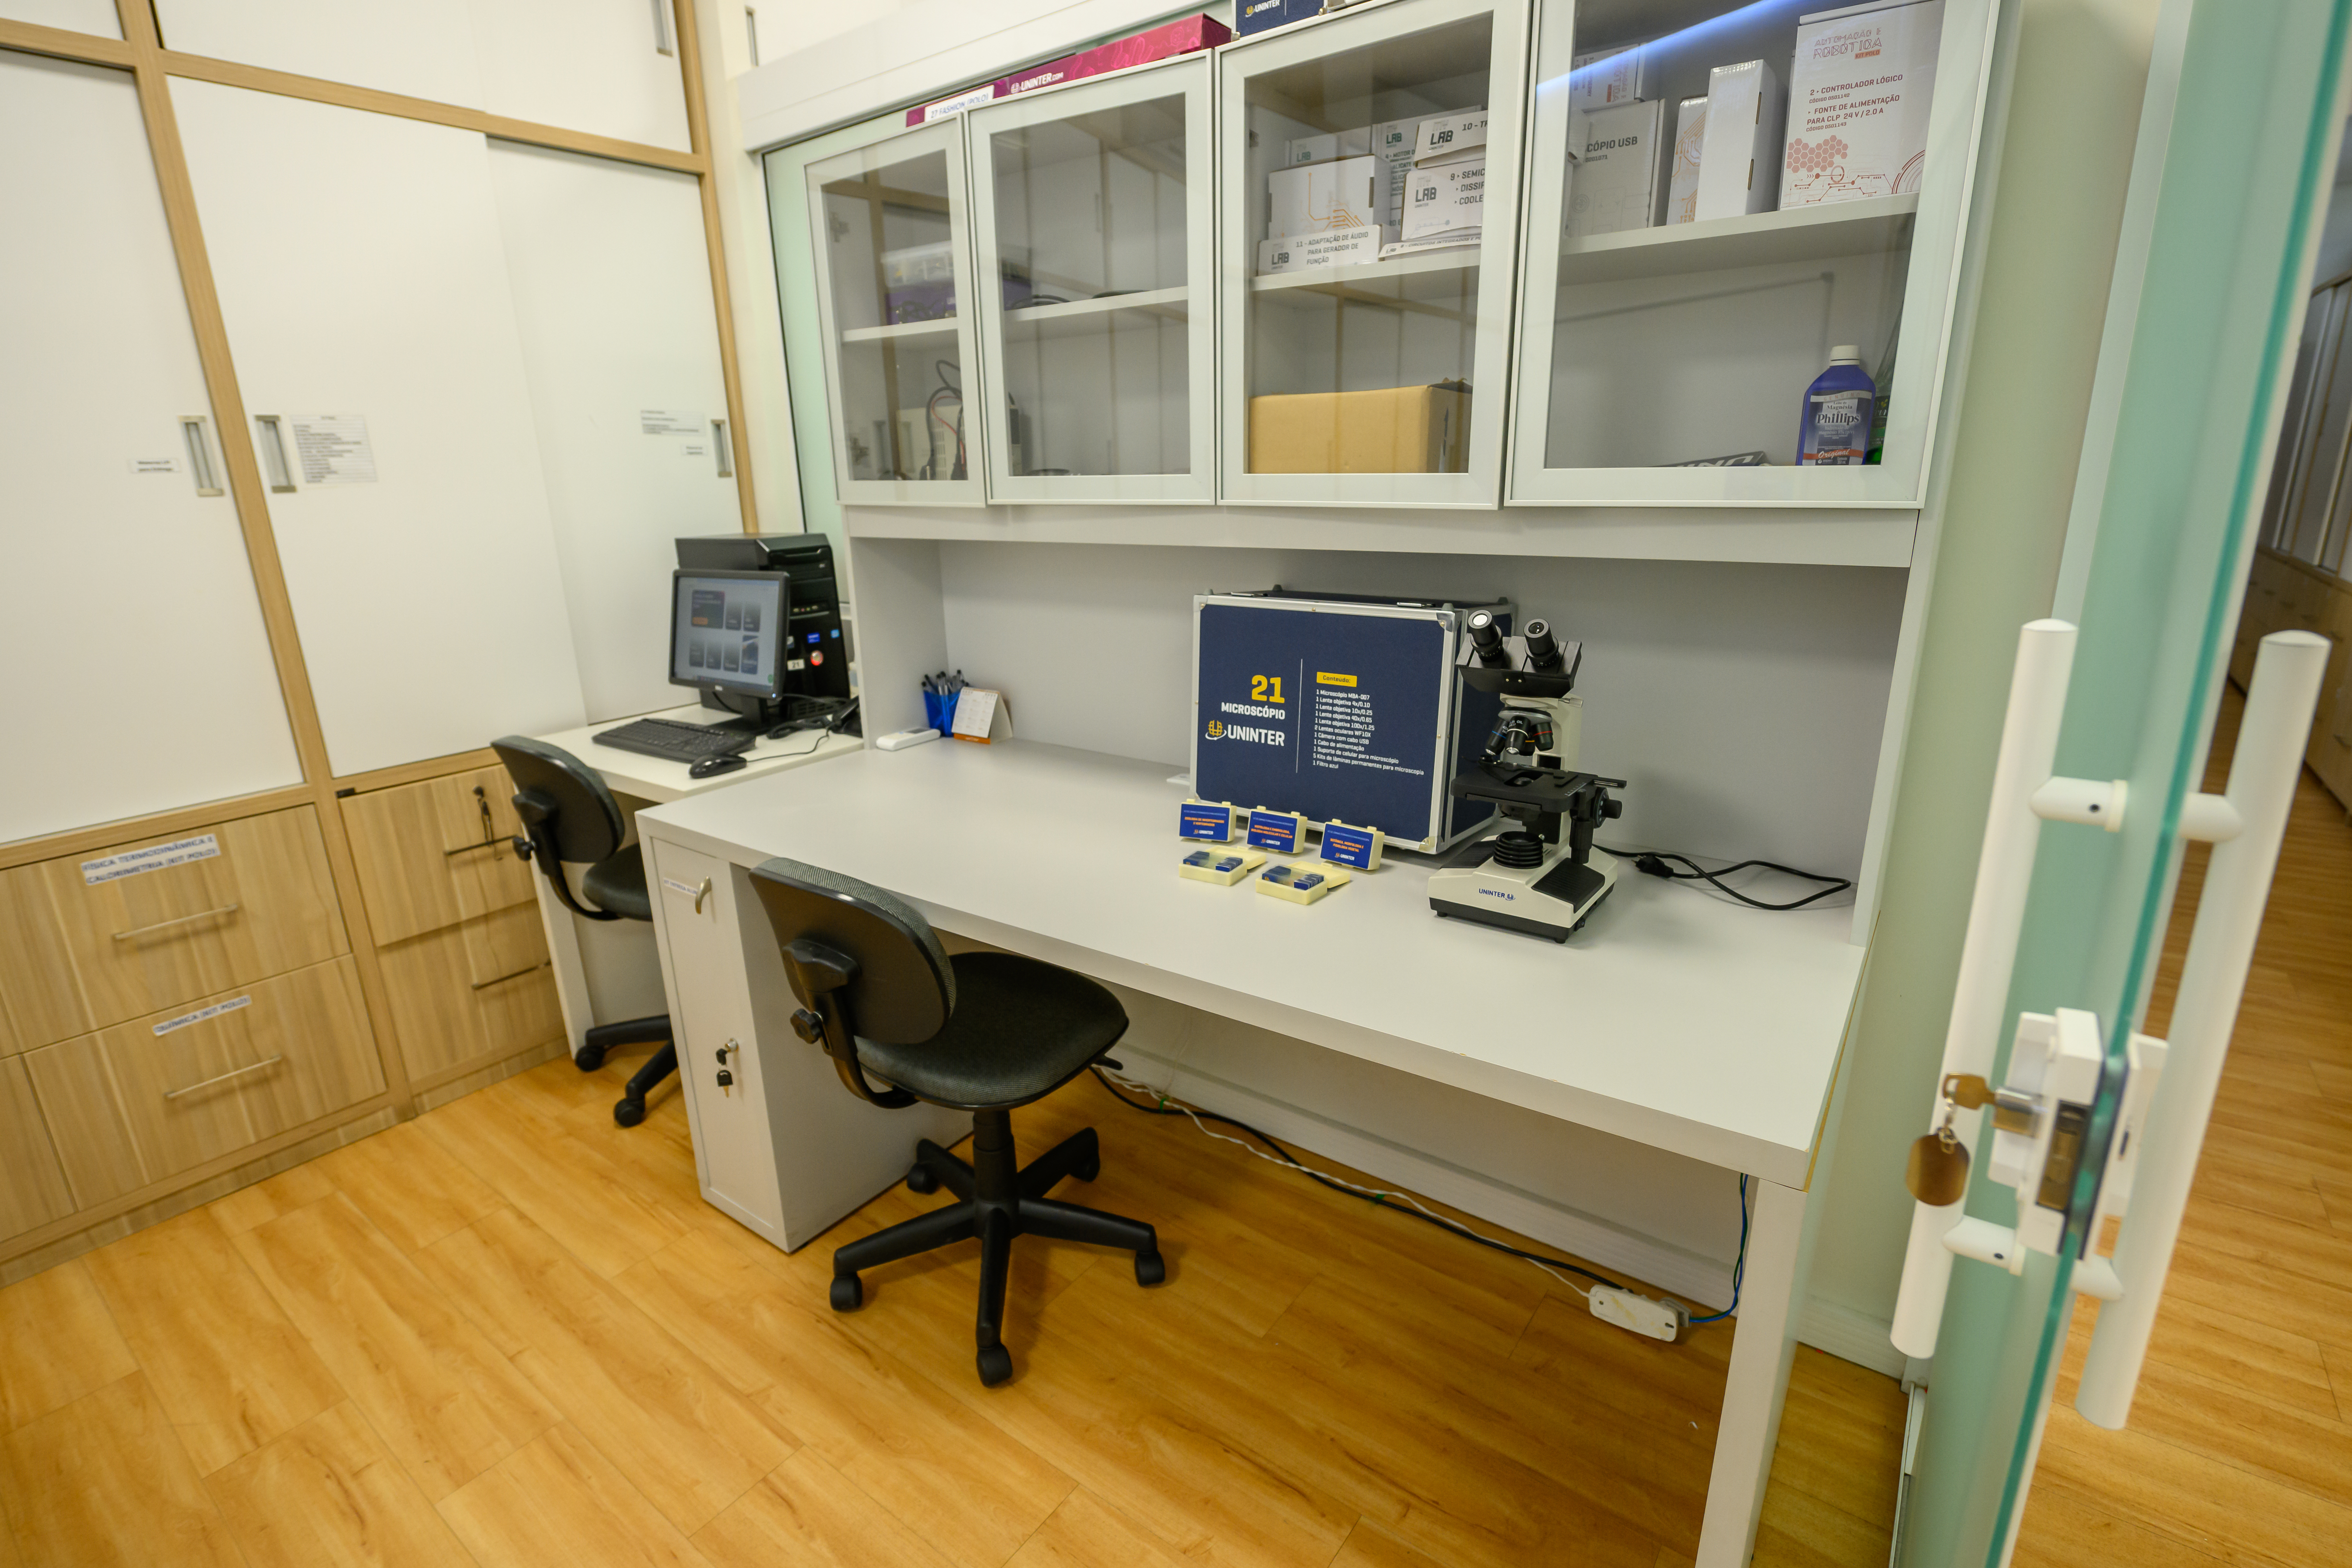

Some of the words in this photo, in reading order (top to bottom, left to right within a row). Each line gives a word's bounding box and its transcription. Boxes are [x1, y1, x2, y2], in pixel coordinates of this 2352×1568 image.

[1255, 0, 1280, 12] UNINTER
[1815, 29, 1872, 47] AUTOMAÇÃO
[1813, 37, 1882, 59] ROBÓTICA
[1821, 79, 1874, 94] CONTROLADOR
[1876, 74, 1903, 85] LÓGICO
[939, 101, 965, 115] FASHION
[967, 93, 989, 105] (POLO)
[1814, 105, 1837, 114] FONTE
[1849, 94, 1900, 109] ALIMENTAÇÃO
[1807, 117, 1825, 125] PARA
[1386, 132, 1402, 144] LAB
[1430, 130, 1454, 146] LAB
[1618, 136, 1637, 147] USB
[1297, 151, 1311, 162] LAB
[1416, 187, 1437, 202] LAB
[1459, 194, 1483, 205] COOLE
[1308, 235, 1340, 245] ADAPTAÇÃO
[1323, 244, 1350, 253] GERADOR
[1272, 252, 1289, 265] LAB
[1307, 256, 1329, 265] FUNÇÃO
[1817, 413, 1859, 425] Phillips
[1818, 449, 1850, 459] Original
[1323, 675, 1351, 683] Conteúdo:
[1251, 675, 1285, 704] 21
[1320, 690, 1347, 698] Microscópio
[1221, 702, 1285, 720] MICROSCÓPIO
[1227, 724, 1285, 746] UNINTER
[1336, 742, 1364, 751] alimentação
[1370, 754, 1399, 764] microscópio
[1351, 759, 1382, 769] permanentes
[1394, 766, 1424, 775] microscopia
[1479, 888, 1505, 898] UNINTER
